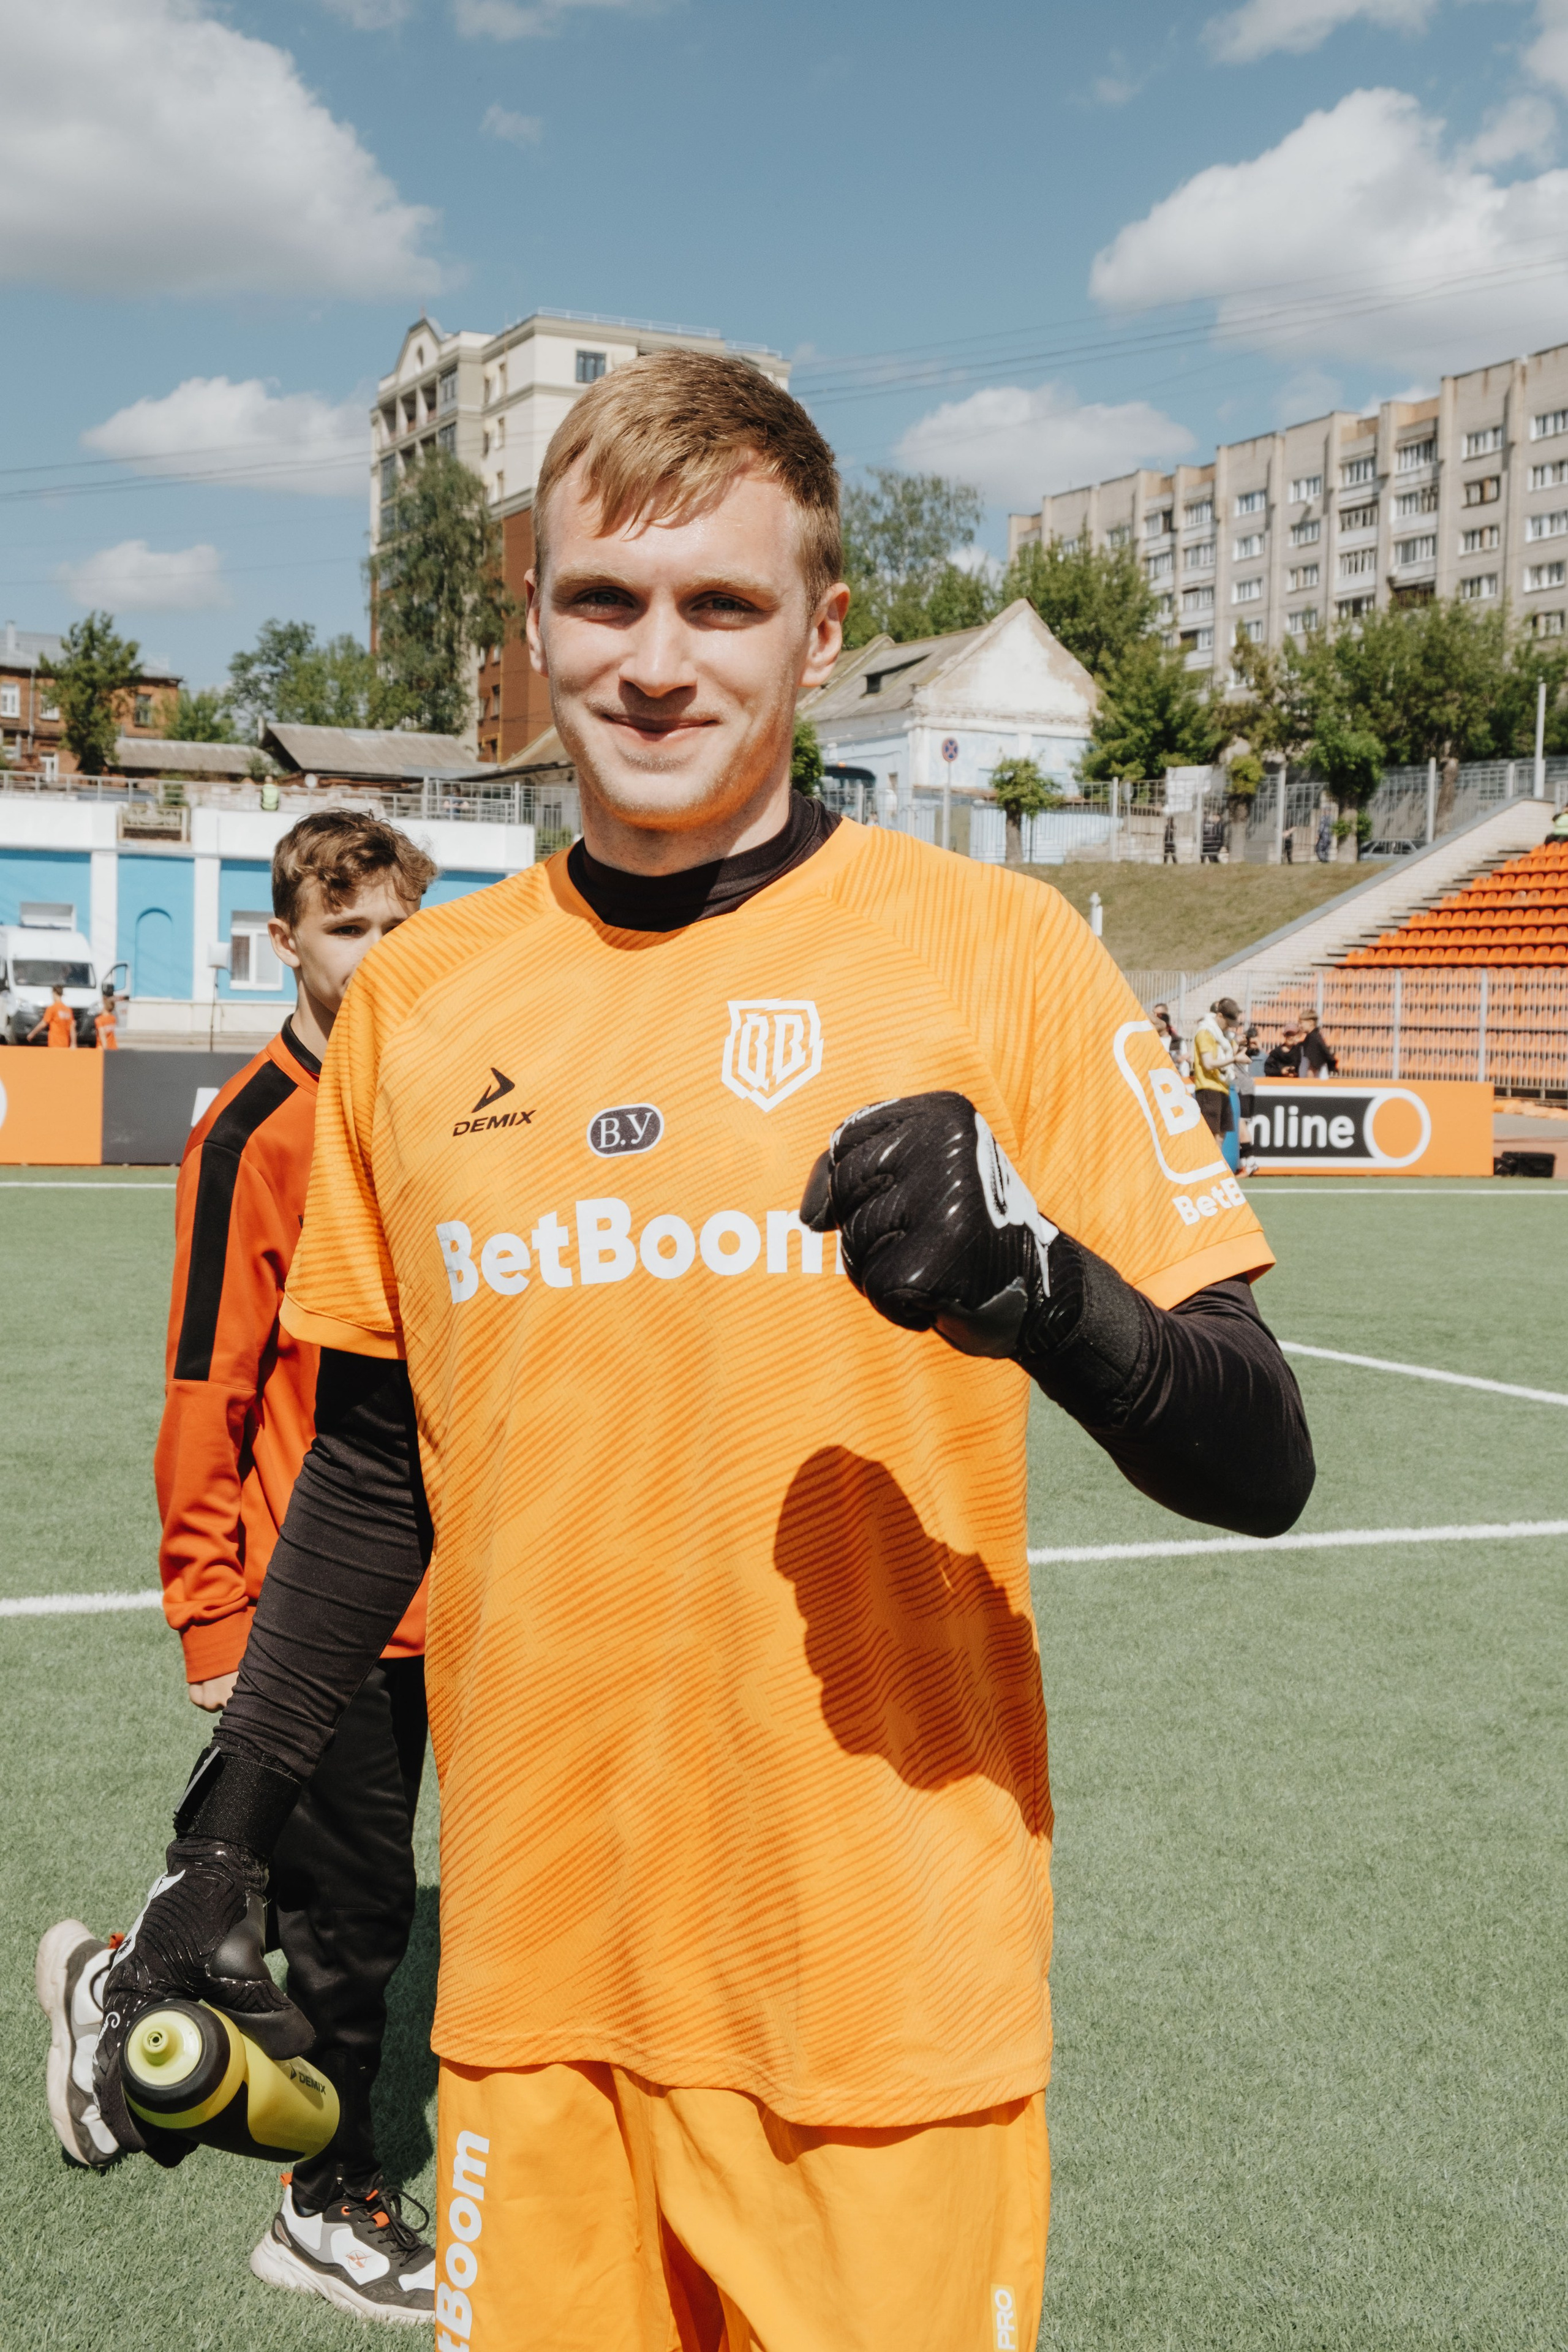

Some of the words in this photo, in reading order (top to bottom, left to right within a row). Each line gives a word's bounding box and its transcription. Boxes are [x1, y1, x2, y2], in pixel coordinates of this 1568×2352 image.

[453, 1109, 537, 1137] DEMIX
[298, 2071, 326, 2095] DEMIX
[994, 2288, 1016, 2350] PRO
